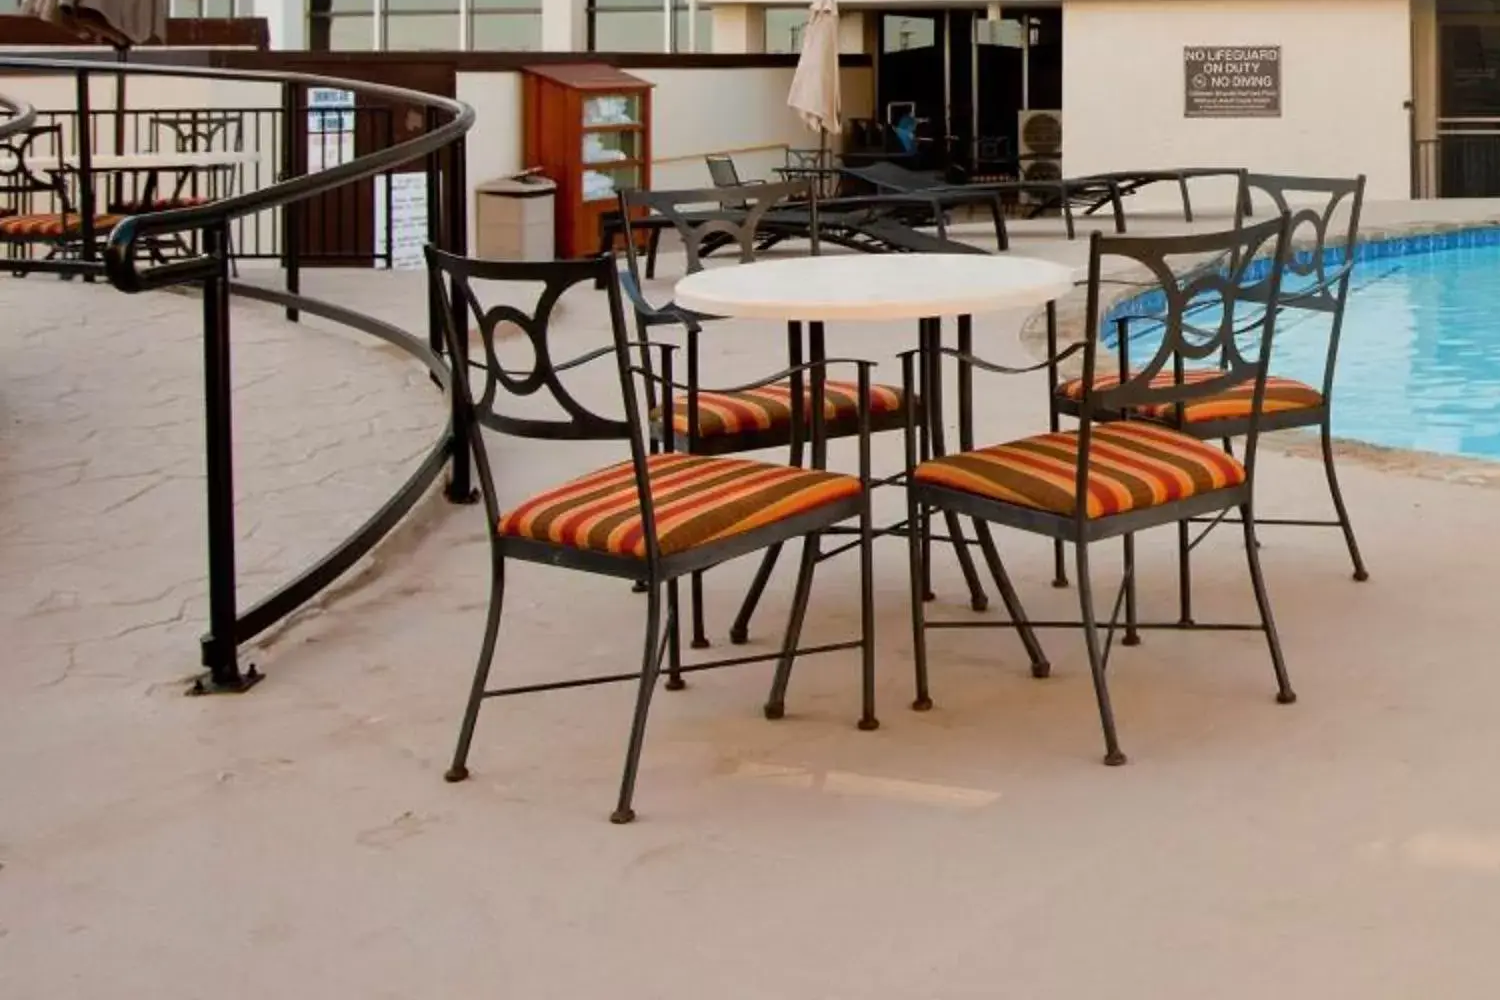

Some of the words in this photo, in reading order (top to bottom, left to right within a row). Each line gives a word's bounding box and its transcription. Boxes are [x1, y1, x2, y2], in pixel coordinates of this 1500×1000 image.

[1186, 49, 1205, 61] NO
[1207, 48, 1277, 61] LIFEGUARD
[1203, 62, 1222, 74] ON
[1224, 62, 1260, 74] DUTY
[1211, 75, 1230, 88] NO
[1232, 75, 1272, 88] DIVING
